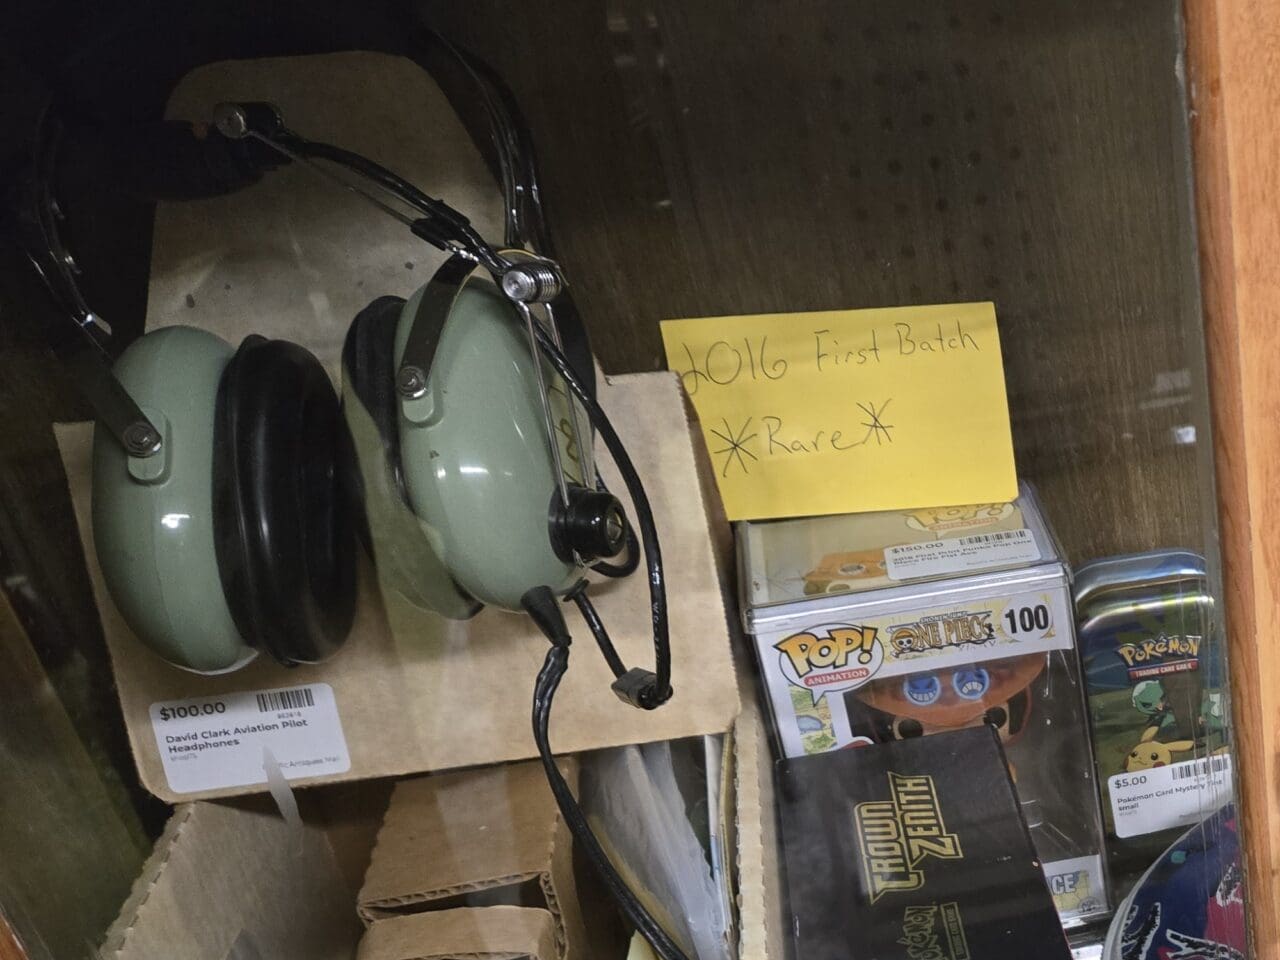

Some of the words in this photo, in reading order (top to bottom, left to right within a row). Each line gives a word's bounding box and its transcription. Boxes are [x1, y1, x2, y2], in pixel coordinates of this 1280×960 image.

[681, 334, 788, 395] 2016
[814, 329, 880, 371] First
[895, 320, 980, 355] Batch
[1004, 604, 1050, 635] 100
[774, 626, 877, 678] POP!
[807, 668, 867, 687] ANIMATION
[159, 701, 226, 722] $100.00
[165, 732, 199, 744] David
[201, 728, 231, 740] Clark
[233, 723, 279, 736] Aviation
[282, 719, 309, 729] Pilot
[168, 737, 240, 755] Headphones
[1114, 775, 1147, 790] $5.00
[1156, 788, 1174, 799] Card
[1118, 802, 1139, 812] small
